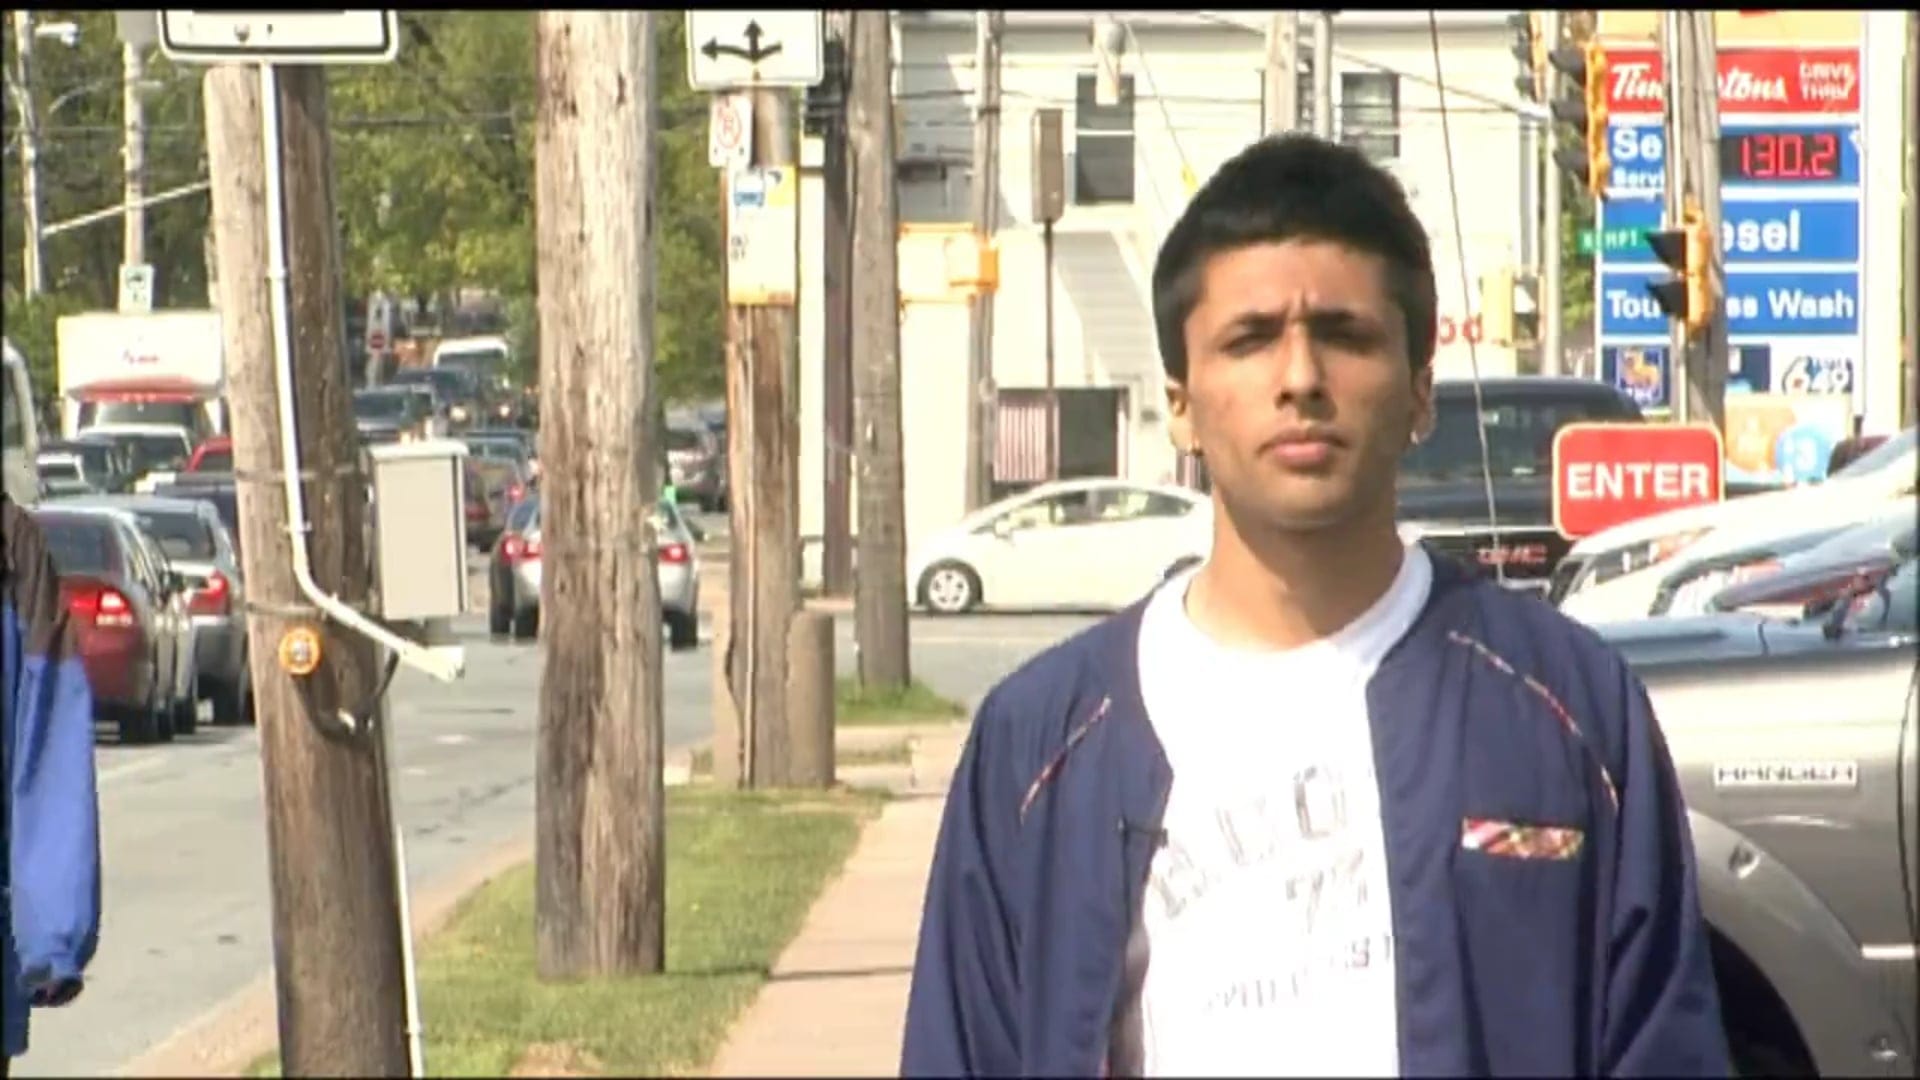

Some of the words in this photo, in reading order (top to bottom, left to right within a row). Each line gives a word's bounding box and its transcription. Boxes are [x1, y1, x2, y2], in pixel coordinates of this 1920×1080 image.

[1717, 66, 1789, 104] tons
[1613, 129, 1663, 162] Se
[1739, 134, 1838, 179] 130.2
[1768, 288, 1855, 319] Wash
[1567, 463, 1709, 500] ENTER
